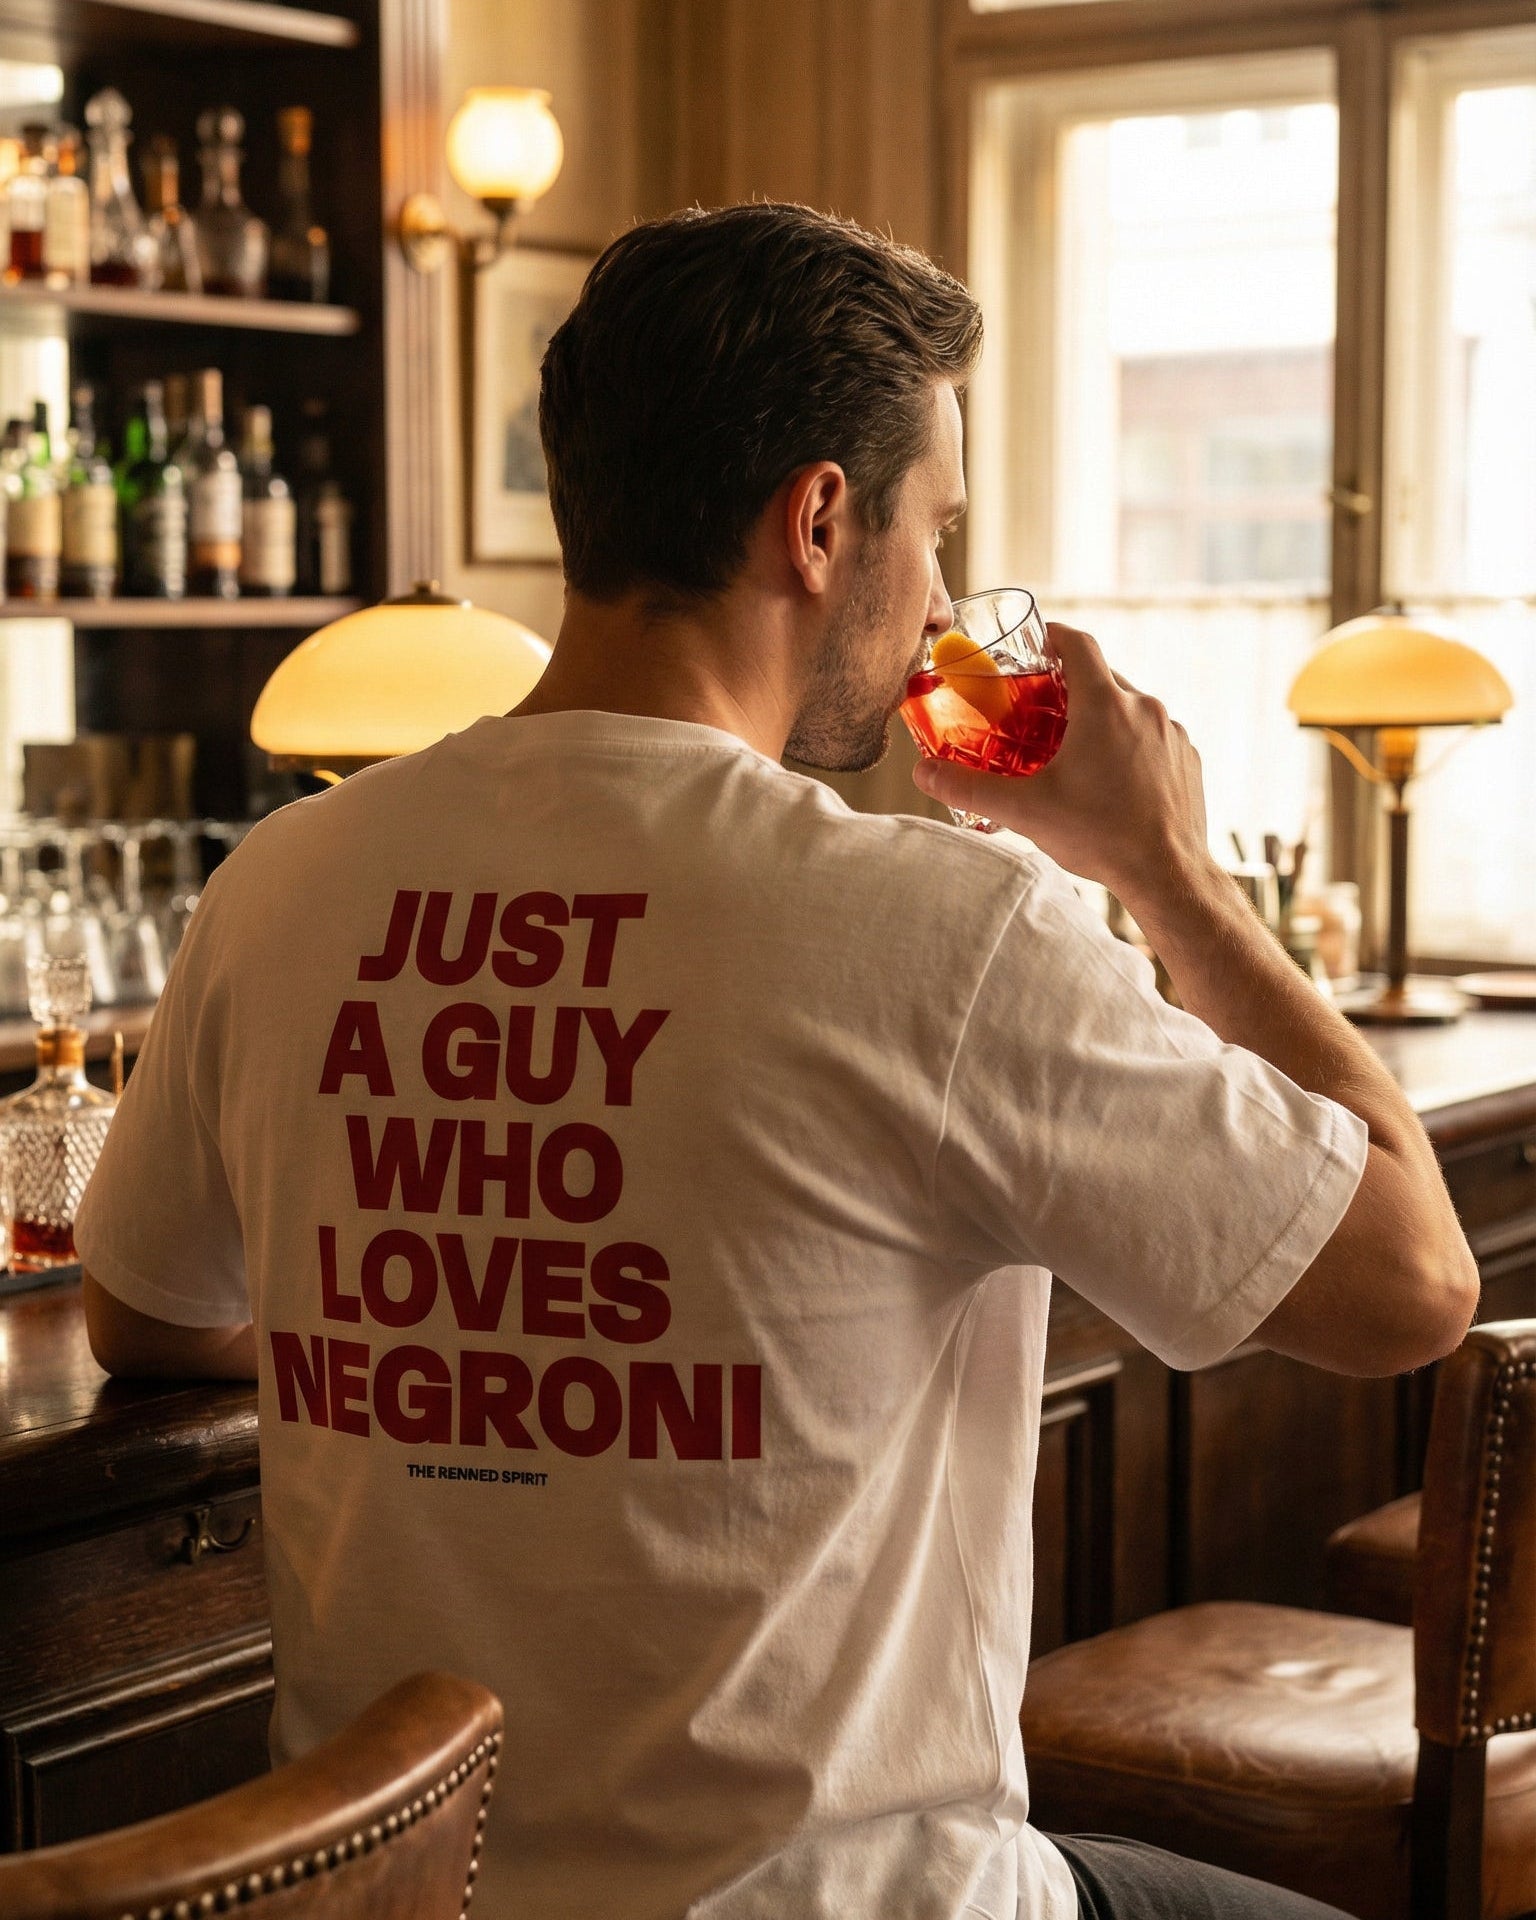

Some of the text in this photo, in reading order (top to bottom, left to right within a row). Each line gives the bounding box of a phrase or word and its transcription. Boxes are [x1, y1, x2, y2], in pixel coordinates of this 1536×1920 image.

[358, 889, 650, 989] JUST
[319, 1000, 671, 1107] A GUY
[344, 1114, 623, 1224] WHO
[315, 1224, 672, 1346] LOVES
[269, 1330, 762, 1462] NEGRONI
[407, 1464, 548, 1486] THE RENNED SPIRIT
